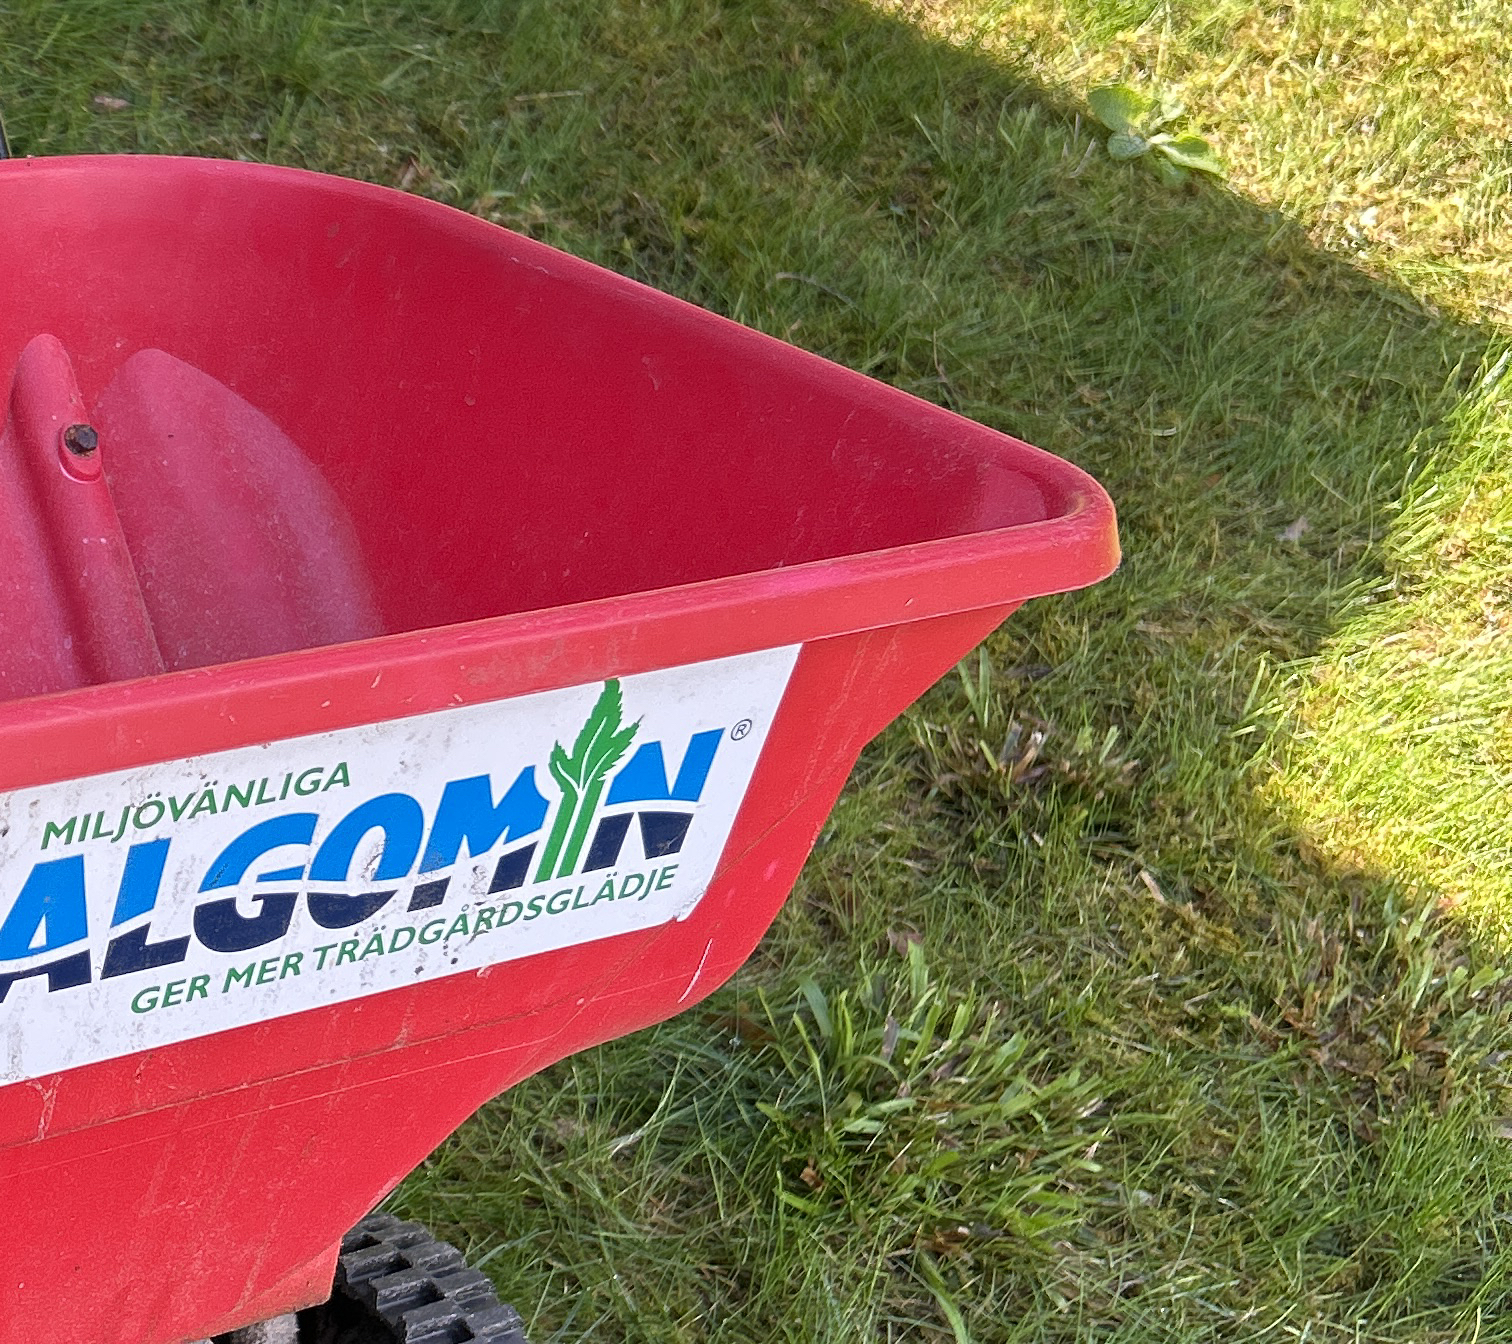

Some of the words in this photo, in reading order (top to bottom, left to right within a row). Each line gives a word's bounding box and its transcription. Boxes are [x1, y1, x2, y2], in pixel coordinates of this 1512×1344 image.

[41, 761, 351, 850] MILJÖVÄNLIGA
[131, 973, 210, 1014] GER
[222, 952, 304, 994] MER
[313, 863, 679, 971] TRÄDGÅRDSGLÄDJE
